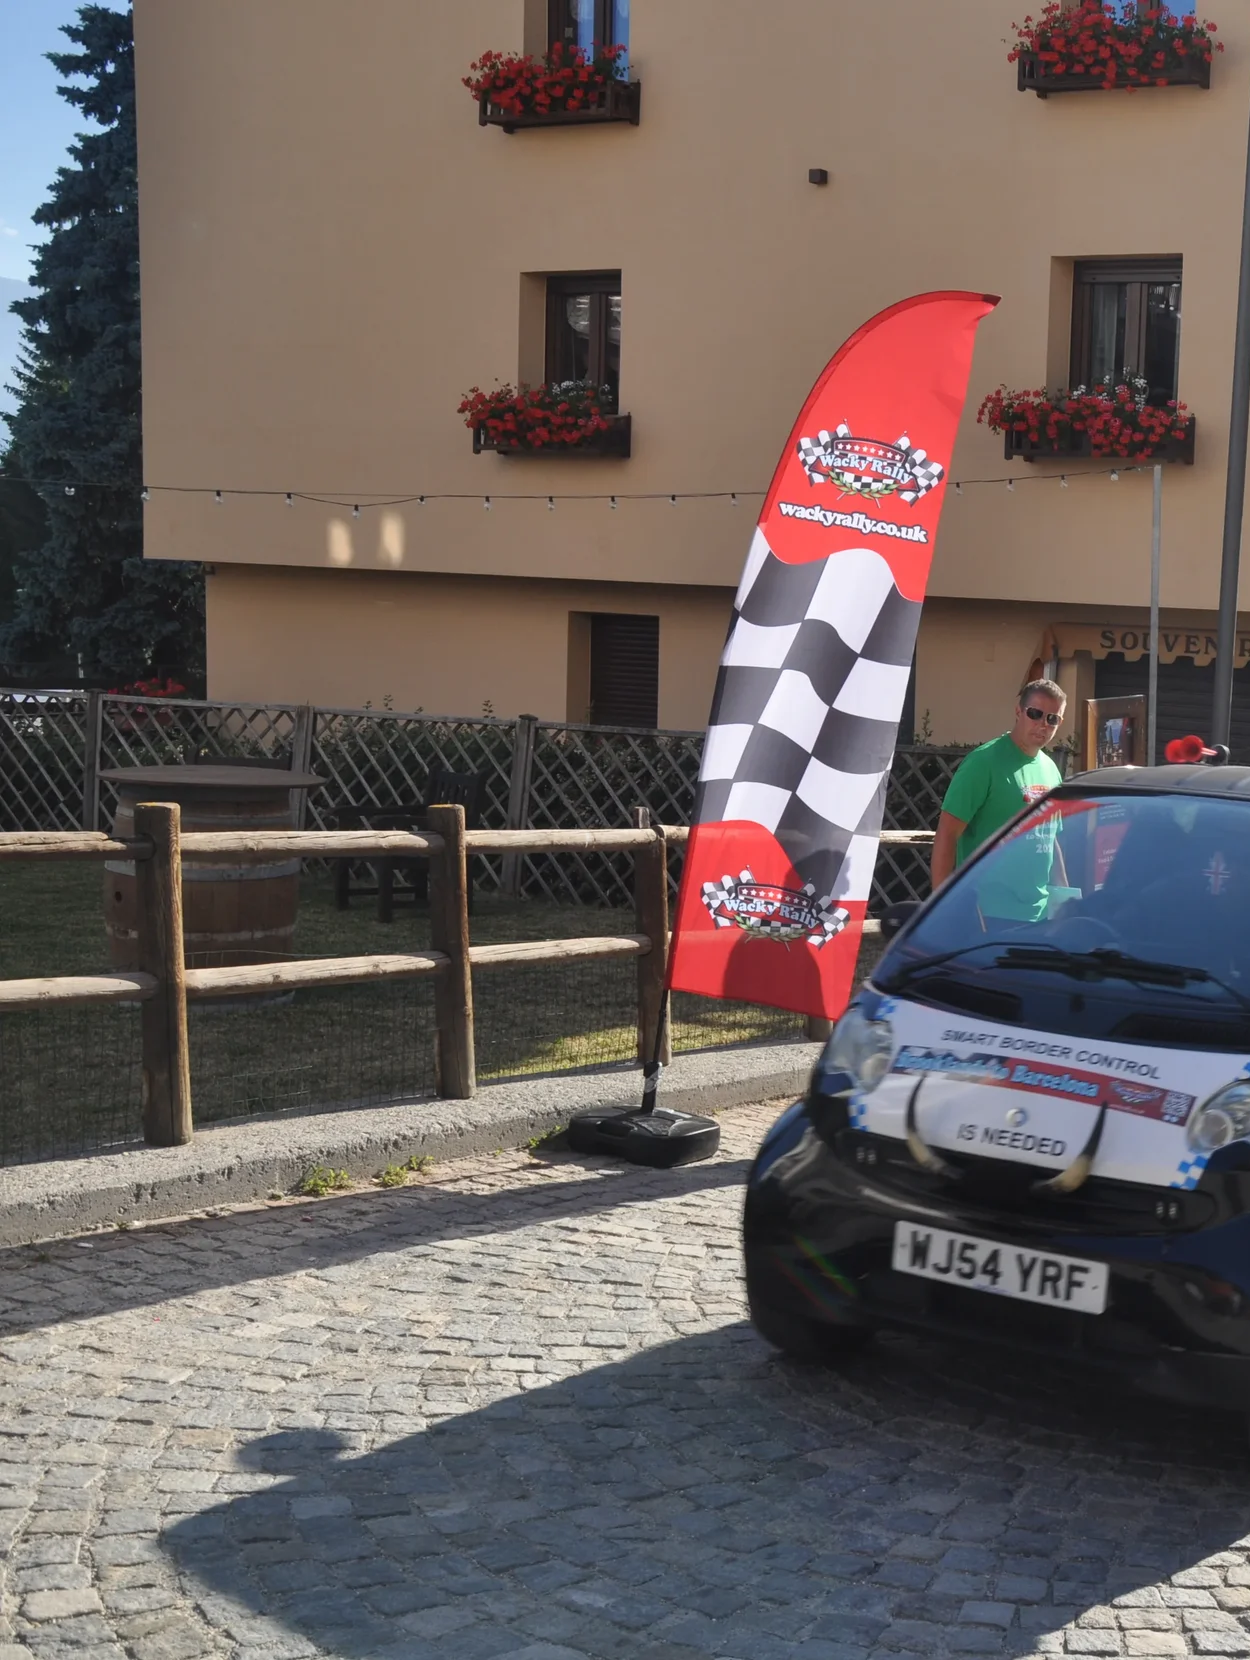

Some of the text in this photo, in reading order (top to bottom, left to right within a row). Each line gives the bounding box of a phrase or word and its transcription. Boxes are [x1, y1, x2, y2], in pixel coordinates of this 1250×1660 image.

[820, 453, 913, 485] Wacky Rally
[778, 502, 928, 544] wackyrally.co.uk
[724, 899, 820, 929] Wacky Rally
[941, 1030, 1161, 1080] SMART BORDER CONTROL
[1011, 1064, 1099, 1097] Barcelona
[957, 1123, 1067, 1157] IS NEEDED
[909, 1230, 1091, 1301] WJ54 YRF
